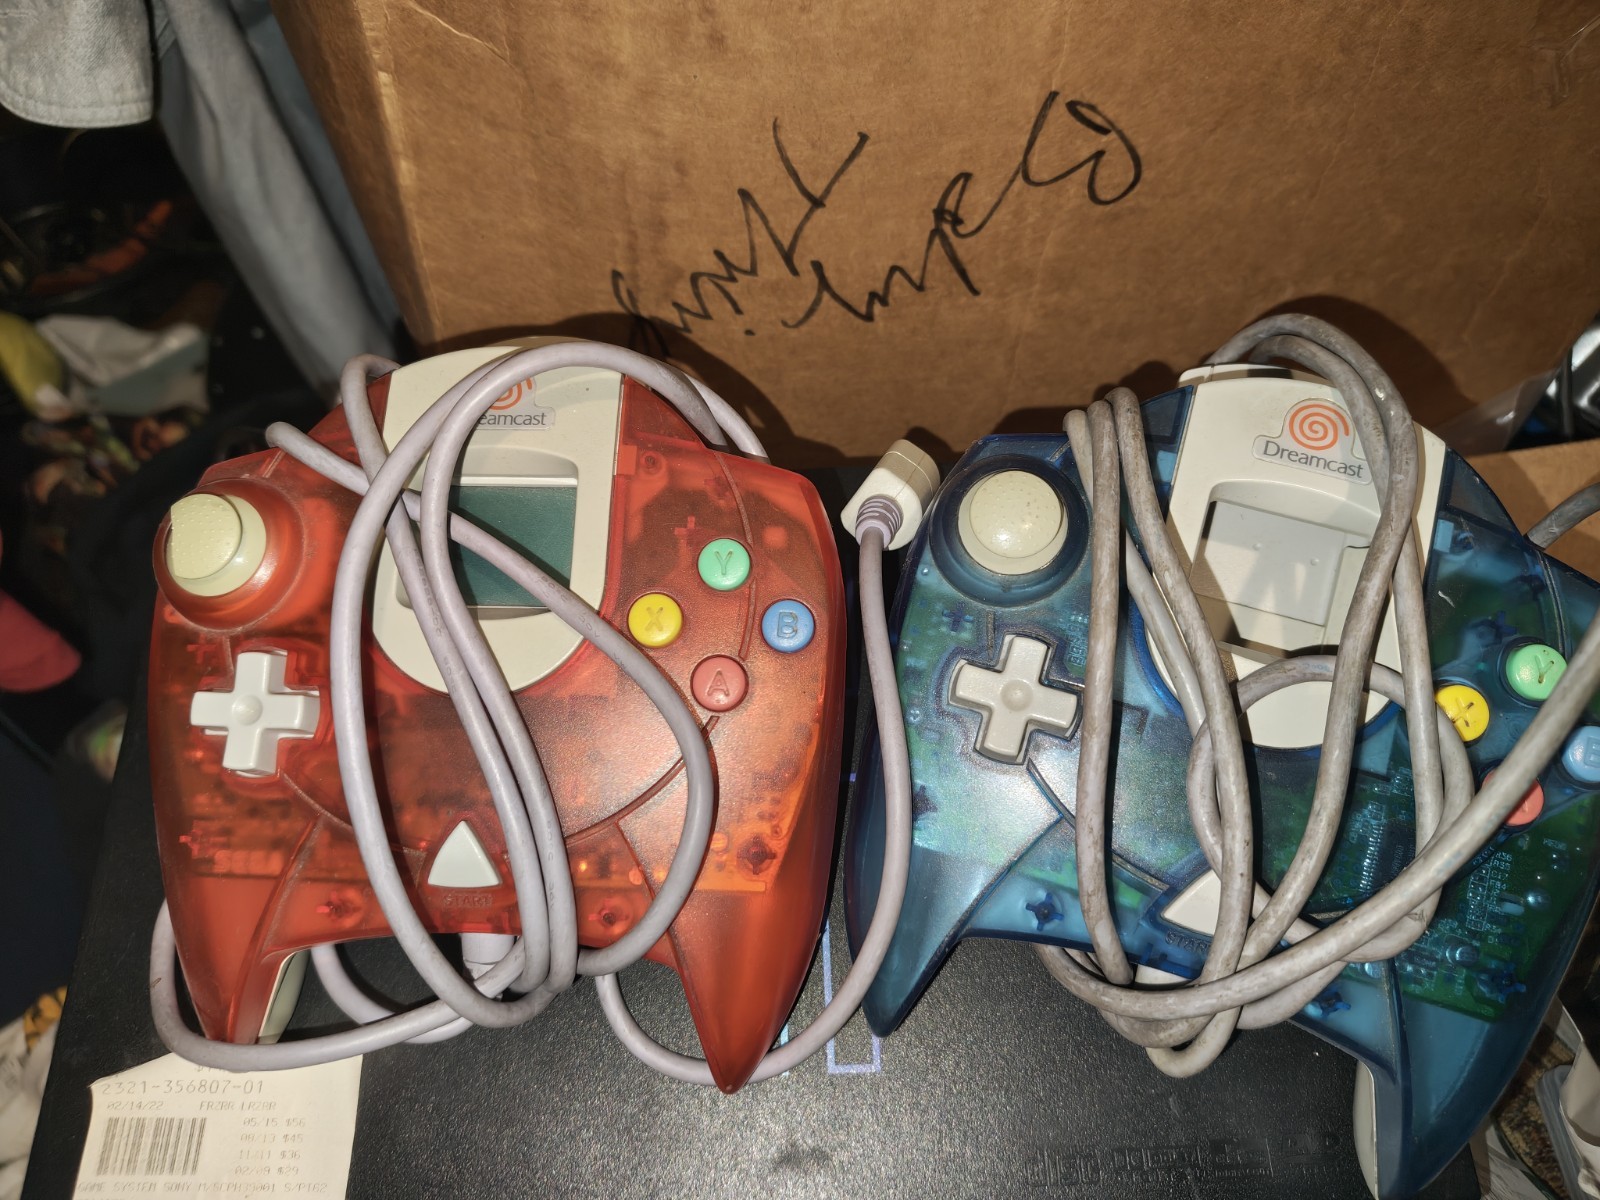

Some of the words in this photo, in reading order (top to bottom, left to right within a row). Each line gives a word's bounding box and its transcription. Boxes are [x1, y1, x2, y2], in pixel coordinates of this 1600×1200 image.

[478, 412, 547, 426] eamcast
[1263, 440, 1365, 479] Dreamcast
[714, 550, 734, 576] Y
[645, 606, 664, 632] X
[776, 611, 799, 639] B
[1534, 654, 1556, 684] Y
[706, 669, 731, 697] A
[443, 893, 494, 907] START
[1165, 931, 1209, 952] STAR
[101, 1079, 264, 1096] 2321-356807-01
[107, 1101, 164, 1111] 02/14/22
[243, 1116, 279, 1128] 05/15
[112, 1181, 158, 1193] SYSTEM
[163, 1181, 191, 1193] SONY
